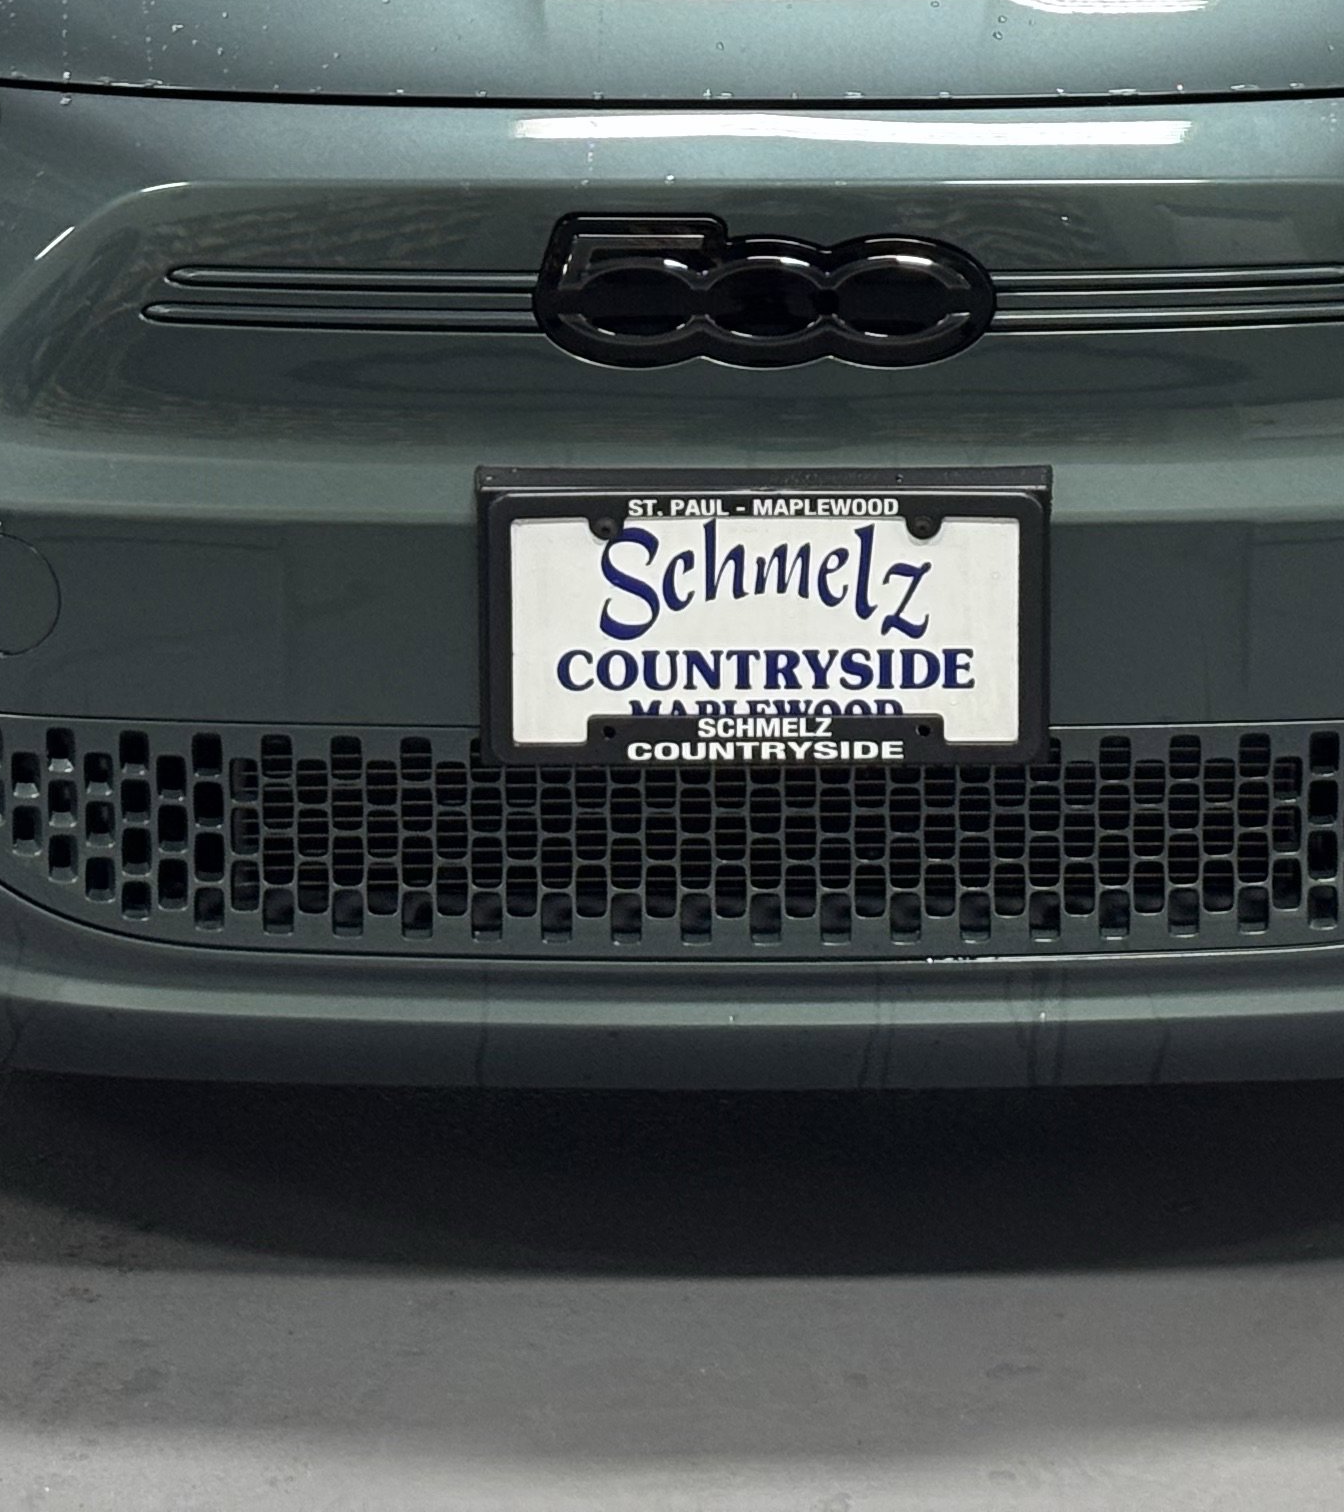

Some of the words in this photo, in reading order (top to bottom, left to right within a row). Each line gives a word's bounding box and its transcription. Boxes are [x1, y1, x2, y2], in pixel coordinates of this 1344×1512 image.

[542, 218, 988, 364] 500
[628, 499, 664, 517] ST.
[670, 499, 730, 517] PAUL
[752, 498, 899, 516] MAPLEWOOD
[598, 520, 932, 640] Schmelz
[556, 649, 975, 690] COUNTRYSIDE
[697, 717, 833, 738] SCHMELZ
[627, 741, 905, 761] COUNTRYSIDE
